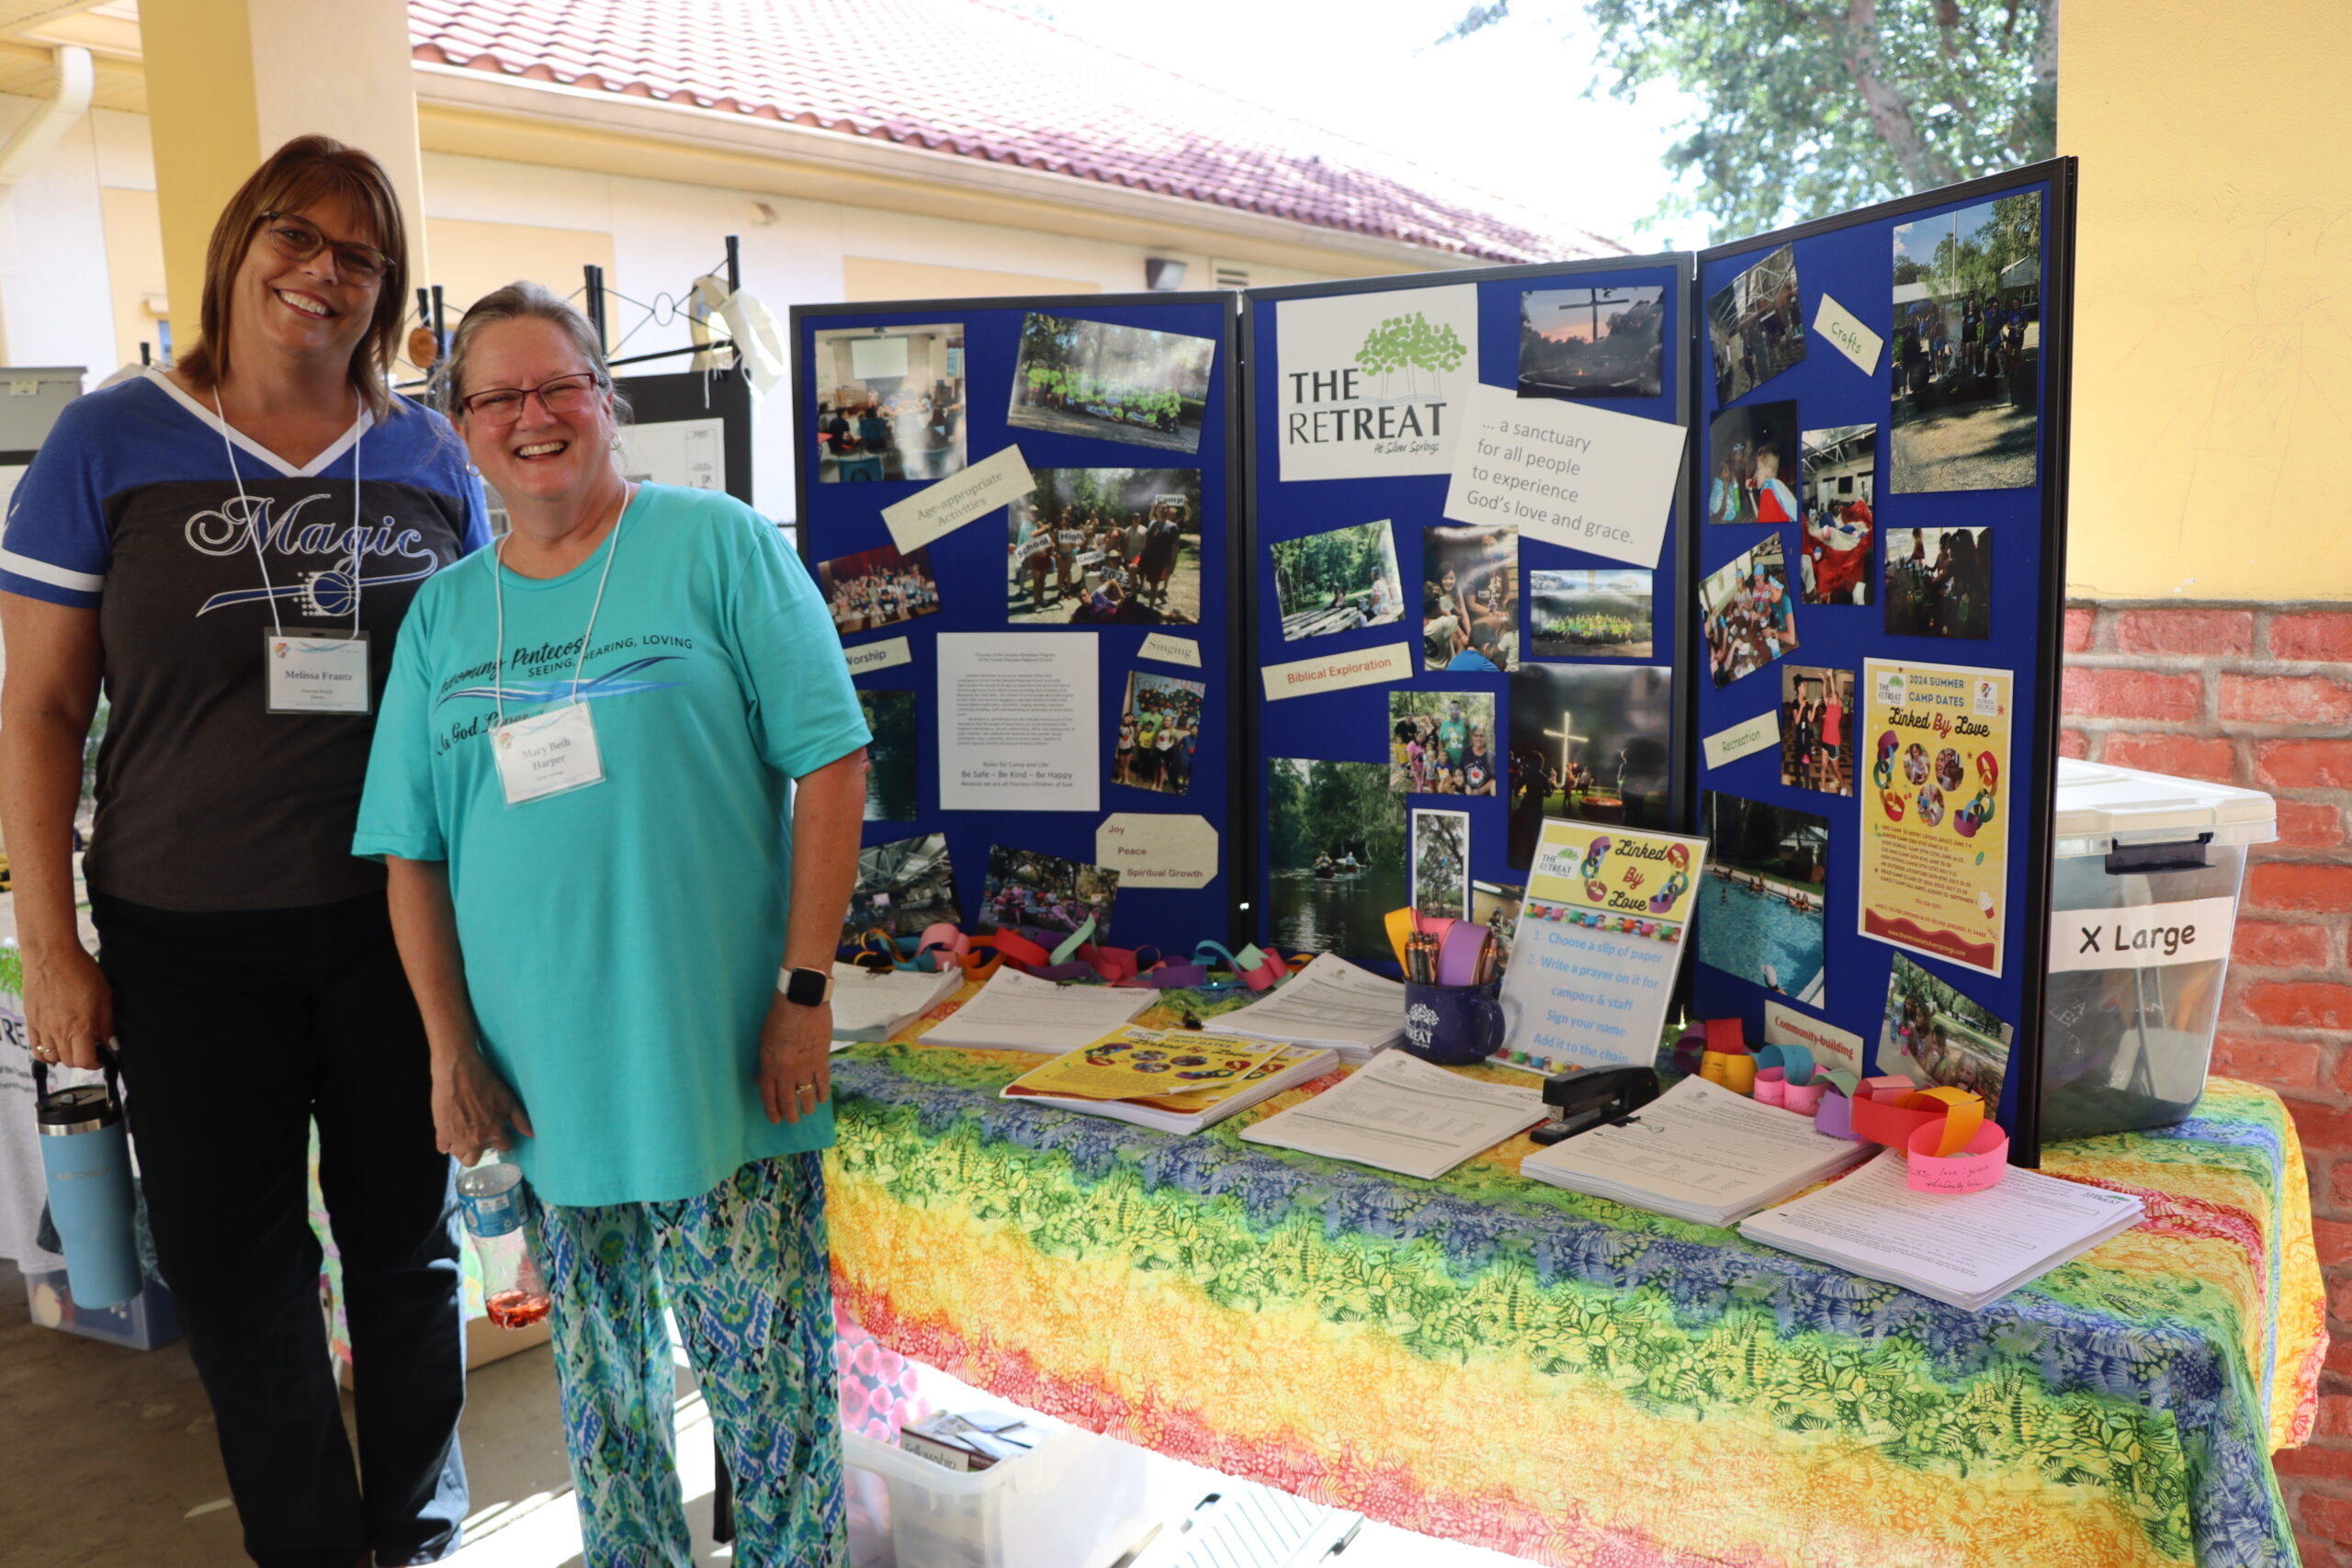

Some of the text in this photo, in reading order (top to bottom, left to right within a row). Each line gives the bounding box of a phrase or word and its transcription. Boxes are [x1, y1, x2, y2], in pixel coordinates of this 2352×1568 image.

[1831, 321, 1861, 354] Crafts
[1289, 368, 1360, 404] THE
[1289, 402, 1447, 445] RETREAT
[1374, 439, 1441, 456] At Silver Springs
[1500, 421, 1510, 433] a
[1513, 423, 1591, 454] sanctuary
[1477, 438, 1581, 476] for all people
[1472, 465, 1579, 502] to experience
[918, 472, 1003, 521] Age-appropriate
[1157, 495, 1184, 505] Camp
[937, 496, 988, 527] Activities
[1467, 490, 1634, 545] God's love and grace.
[185, 493, 425, 575] Magic
[1060, 532, 1083, 543] High
[1017, 538, 1049, 558] School
[1102, 568, 1130, 584] 2023
[528, 635, 693, 677] SEEING, HEARING, LOVING
[1148, 637, 1192, 660] Singing
[284, 670, 320, 680] Melissa
[1286, 659, 1392, 684] Biblical Exploration
[1909, 675, 1964, 689] 2024 SUMMER
[1878, 691, 1902, 701] RETREAT
[1879, 682, 1889, 691] THE
[1909, 692, 1964, 707] CAMP DATES
[451, 716, 479, 744] God
[1889, 707, 1991, 739] Linked By Love
[521, 738, 571, 760] Mary Beth
[1722, 730, 1761, 752] Recreation
[532, 755, 566, 771] Harper
[961, 770, 971, 778] Be
[972, 770, 990, 779] Safe
[998, 770, 1009, 779] Be
[1010, 770, 1027, 779] Kind
[1035, 771, 1046, 779] Be
[1047, 771, 1073, 781] Happy
[1108, 825, 1125, 835] Joy
[1117, 846, 1148, 856] Peace
[1542, 853, 1558, 863] THE
[1615, 839, 1669, 862] Linked
[1126, 868, 1204, 879] Spiritual Growth
[1539, 862, 1573, 874] RETREAT
[1623, 866, 1645, 889] By
[1608, 891, 1648, 911] Love
[1548, 932, 1586, 949] Choose
[1588, 941, 1596, 951] a
[1597, 942, 1615, 955] slip
[1617, 946, 1630, 956] of
[1630, 949, 1664, 964] paper
[2079, 924, 2196, 956] X Large
[1541, 955, 1570, 973] Write
[1571, 964, 1578, 974] a
[1579, 964, 1614, 980] prayer
[1616, 973, 1629, 984] on
[1632, 975, 1641, 986] it
[1642, 976, 1659, 989] for
[1551, 986, 1634, 1011] campers & staff
[1546, 1009, 1626, 1036] Sign your name
[1533, 1033, 1629, 1064] Add it to the chain
[1775, 1015, 1854, 1061] Community-building
